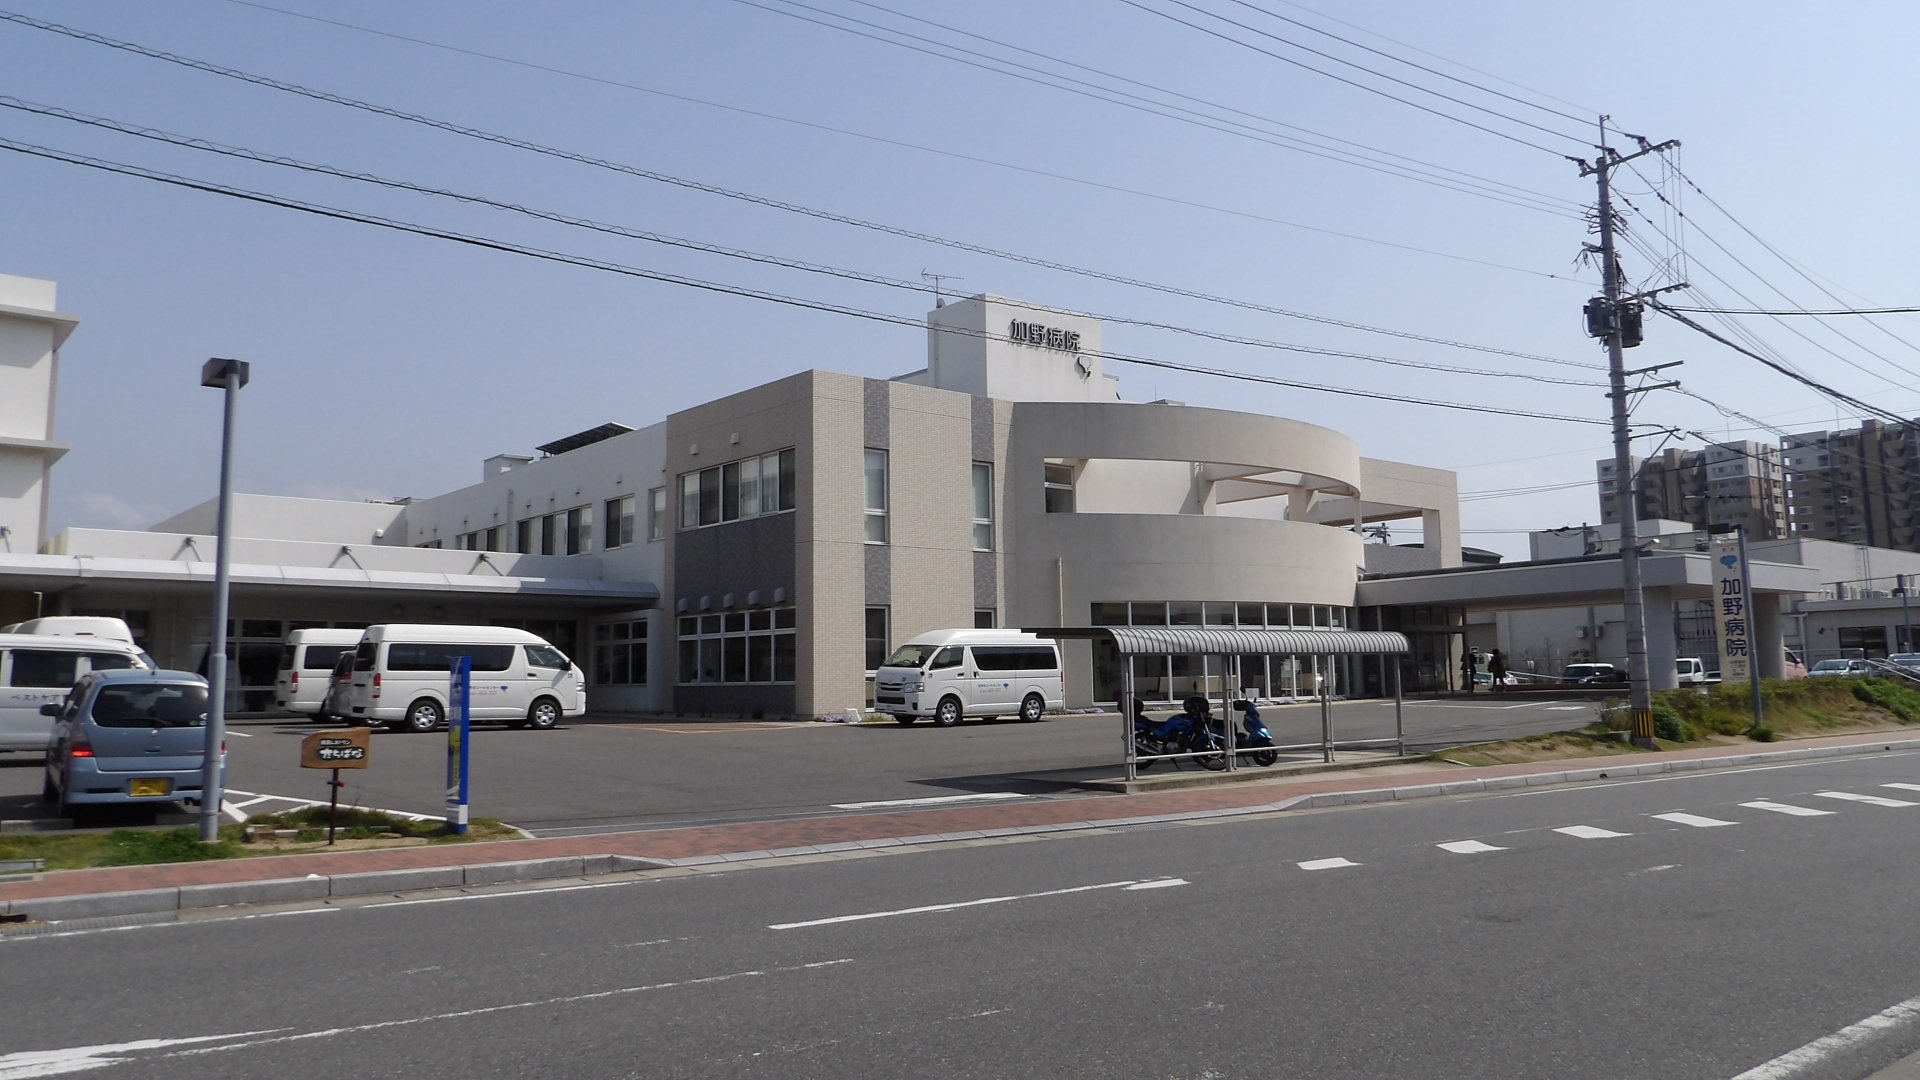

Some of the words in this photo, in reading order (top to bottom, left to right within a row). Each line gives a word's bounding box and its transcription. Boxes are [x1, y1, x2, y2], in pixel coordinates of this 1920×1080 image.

[1011, 318, 1081, 351] 加野病院
[1720, 578, 1747, 657] 加野病院
